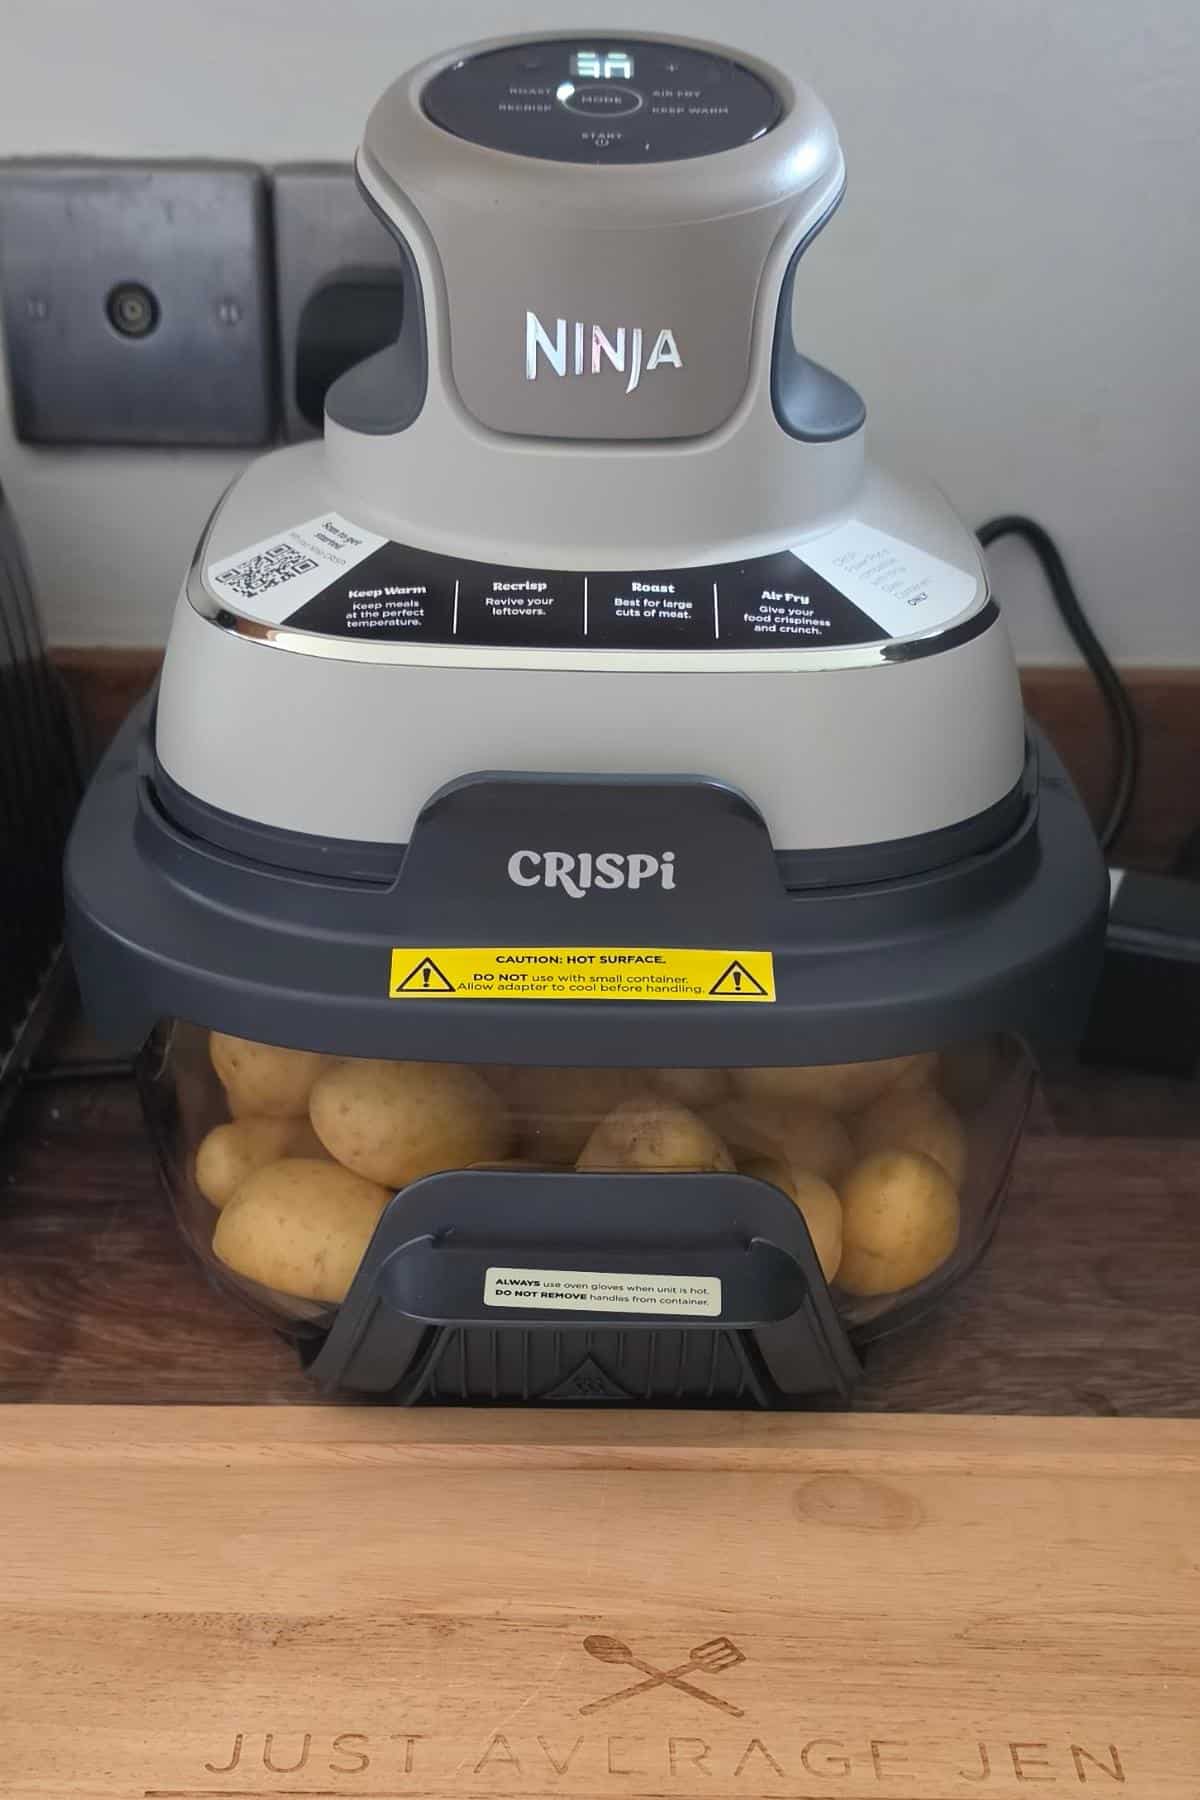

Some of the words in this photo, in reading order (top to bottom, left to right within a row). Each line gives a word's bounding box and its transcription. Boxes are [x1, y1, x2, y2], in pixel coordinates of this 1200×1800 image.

[526, 311, 683, 394] NINJA
[348, 589, 382, 600] Keep
[384, 585, 427, 596] Warm
[492, 580, 548, 593] Recrisp
[631, 582, 676, 594] Roast
[485, 597, 525, 606] Revive
[526, 598, 554, 608] your
[614, 598, 641, 607] Best
[643, 597, 661, 607] for
[663, 599, 693, 610] large
[761, 590, 783, 601] Air
[785, 592, 810, 605] Fry
[352, 602, 383, 612] Keep
[385, 599, 420, 608] meals
[491, 607, 547, 616] leftovers.
[759, 605, 785, 614] Give
[788, 608, 815, 618] your
[346, 611, 358, 619] at
[360, 609, 381, 618] the
[382, 607, 425, 619] perfect
[615, 608, 641, 617] cuts
[643, 608, 656, 617] of
[658, 610, 692, 619] meat.
[347, 618, 422, 629] temperature.
[743, 613, 772, 623] food
[773, 615, 831, 627] crispiness
[753, 624, 777, 633] and
[779, 625, 822, 635] crunch.
[508, 850, 677, 898] CRISPi
[495, 955, 563, 965] CAUTION:
[566, 955, 596, 965] HOT
[599, 955, 667, 965] SURFACE.
[473, 973, 495, 982] DO
[498, 973, 529, 982] NOT
[558, 973, 586, 982] with
[589, 974, 623, 983] small
[626, 975, 689, 984] container.
[456, 982, 494, 991] Allow
[551, 983, 566, 991] to
[569, 983, 597, 992] cool
[600, 984, 643, 993] before
[646, 984, 705, 995] handling.
[495, 1278, 541, 1287] ALWAYS
[591, 1283, 624, 1291] gloves
[626, 1285, 655, 1293] when
[656, 1286, 677, 1294] unit
[514, 1290, 538, 1298] NOT
[540, 1291, 588, 1300] REMOVE
[589, 1294, 630, 1302] handles
[632, 1295, 658, 1304] from
[203, 1732, 433, 1775] JUST
[471, 1733, 916, 1782] AVERAGE
[958, 1741, 1128, 1784] JEN
